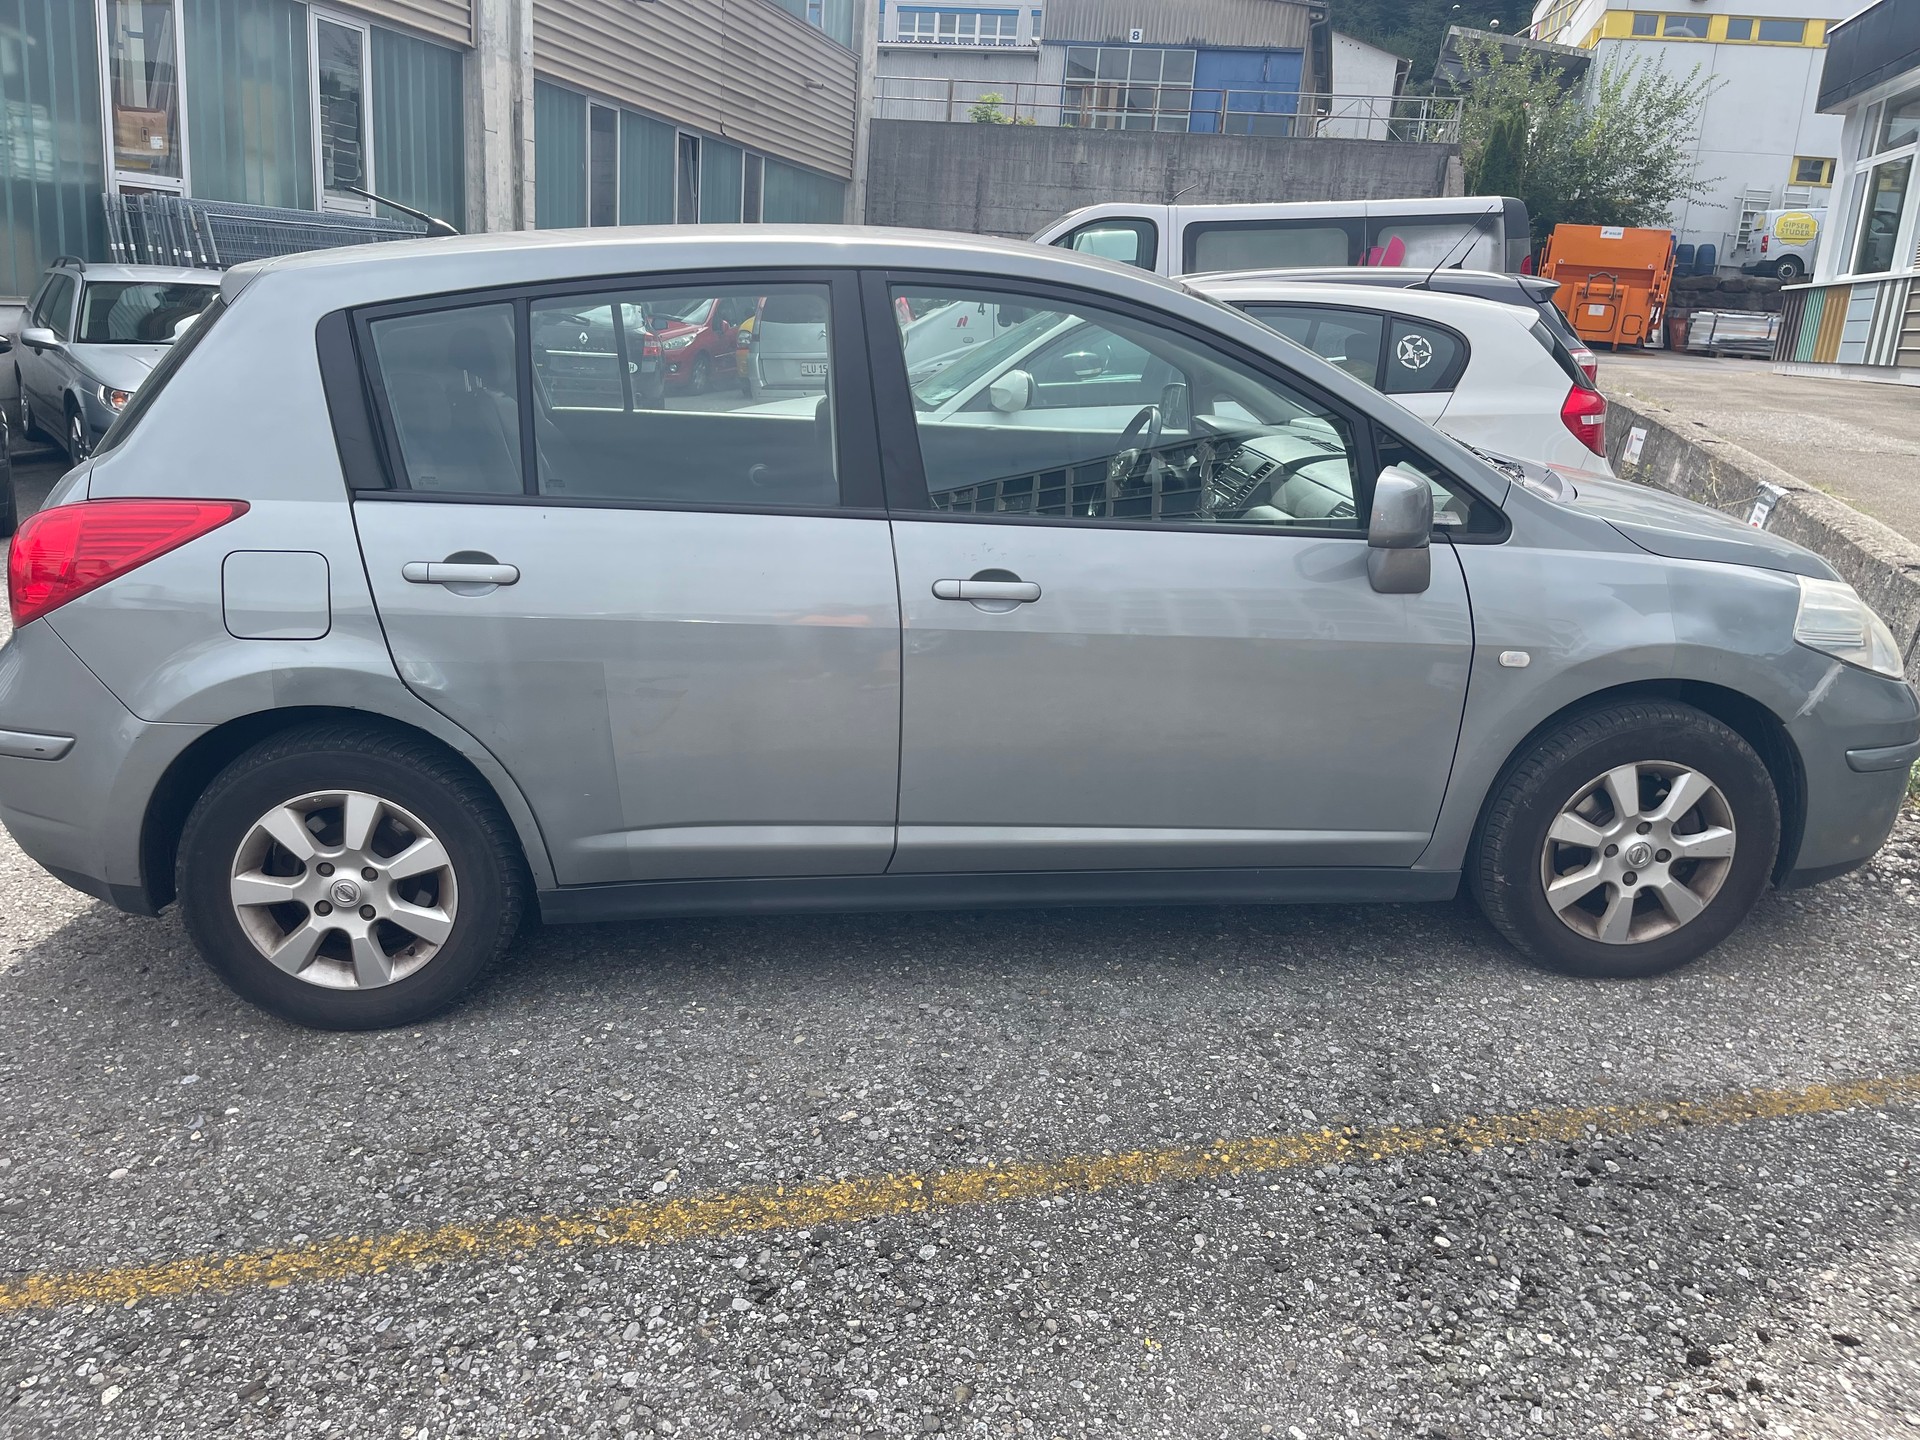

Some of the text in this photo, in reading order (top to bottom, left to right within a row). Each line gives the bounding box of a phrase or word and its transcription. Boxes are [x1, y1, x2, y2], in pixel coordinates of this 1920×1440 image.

[1132, 31, 1140, 41] 8
[1783, 221, 1810, 230] GIPSER
[1781, 227, 1810, 237] STUDER
[977, 302, 985, 315] 4
[806, 363, 828, 374] LU 15
